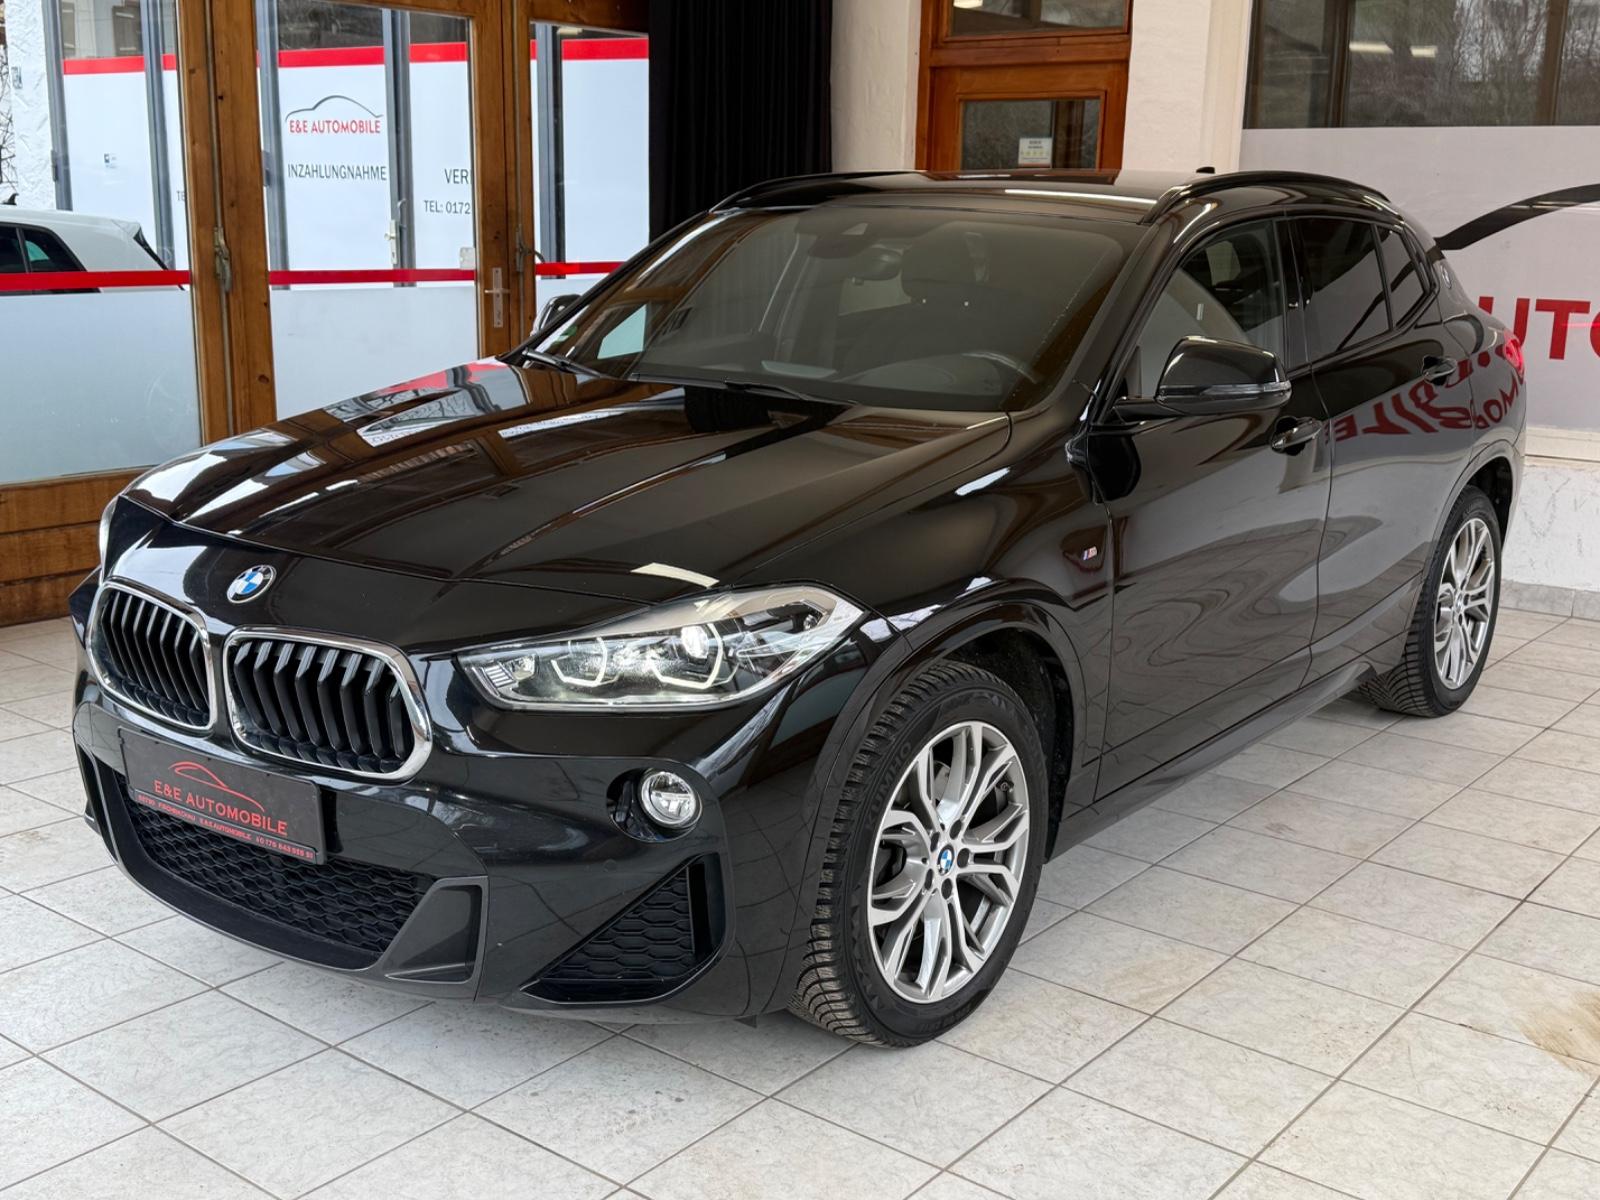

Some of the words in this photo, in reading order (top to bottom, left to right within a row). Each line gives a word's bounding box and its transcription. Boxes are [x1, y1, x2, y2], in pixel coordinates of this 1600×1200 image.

[289, 120, 308, 134] E&E
[310, 119, 381, 134] AUTOMOBILE
[287, 163, 388, 181] INZAHLUNGNAHME
[423, 200, 443, 214] TEL:
[445, 201, 471, 215] 0172
[153, 780, 182, 800] E&E
[185, 792, 289, 837] AUTOMOBILE
